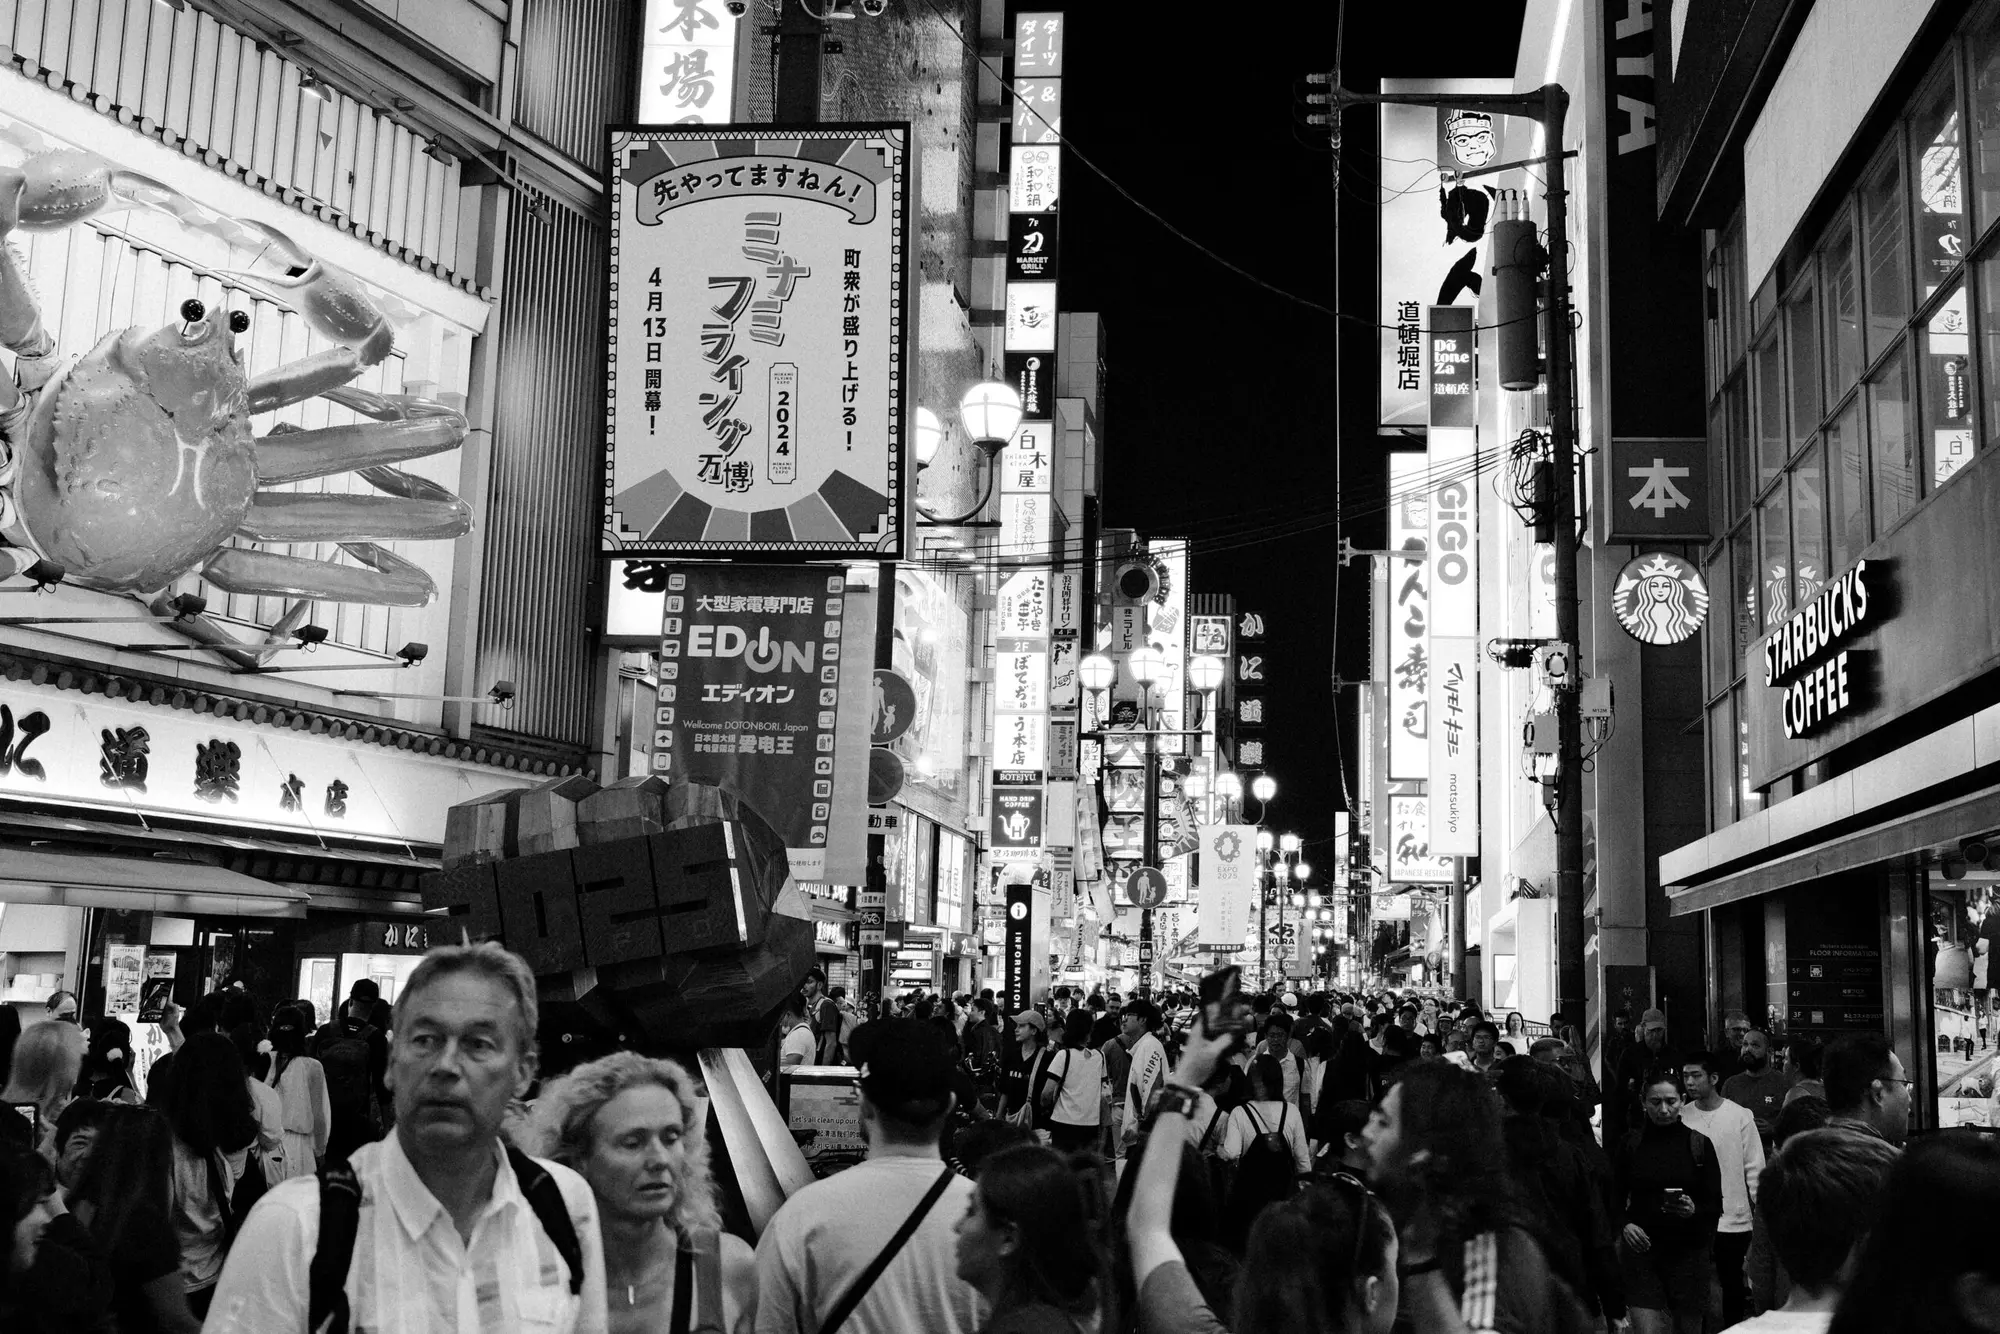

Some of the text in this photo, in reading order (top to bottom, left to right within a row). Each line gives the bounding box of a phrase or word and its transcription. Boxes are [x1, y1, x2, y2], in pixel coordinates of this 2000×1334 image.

[653, 163, 862, 205] 先やってますねん!
[643, 267, 667, 436] 4月13日開幕!
[842, 248, 861, 451] 町衆が盛り上げる!
[1397, 301, 1421, 391] 道頓堀店
[1433, 382, 1470, 396] 道頓座
[776, 391, 790, 456] 2024
[1016, 430, 1047, 488] 白木屋
[1628, 458, 1691, 518] 本
[695, 595, 814, 615] 大型家電専門店
[1764, 558, 1868, 688] STARBUCKS
[1014, 642, 1029, 652] 2F
[701, 683, 796, 704] エディオン
[1781, 650, 1849, 740] COFFEE
[783, 722, 809, 734] Japan
[1000, 773, 1037, 781] BOTEJYU
[1448, 773, 1457, 833] matsukiyo
[1029, 836, 1039, 845] 1F
[1394, 869, 1423, 877] JAPANESE
[384, 923, 428, 948] かに
[1143, 1050, 1160, 1084] STRIPES
[816, 1116, 834, 1124] clean
